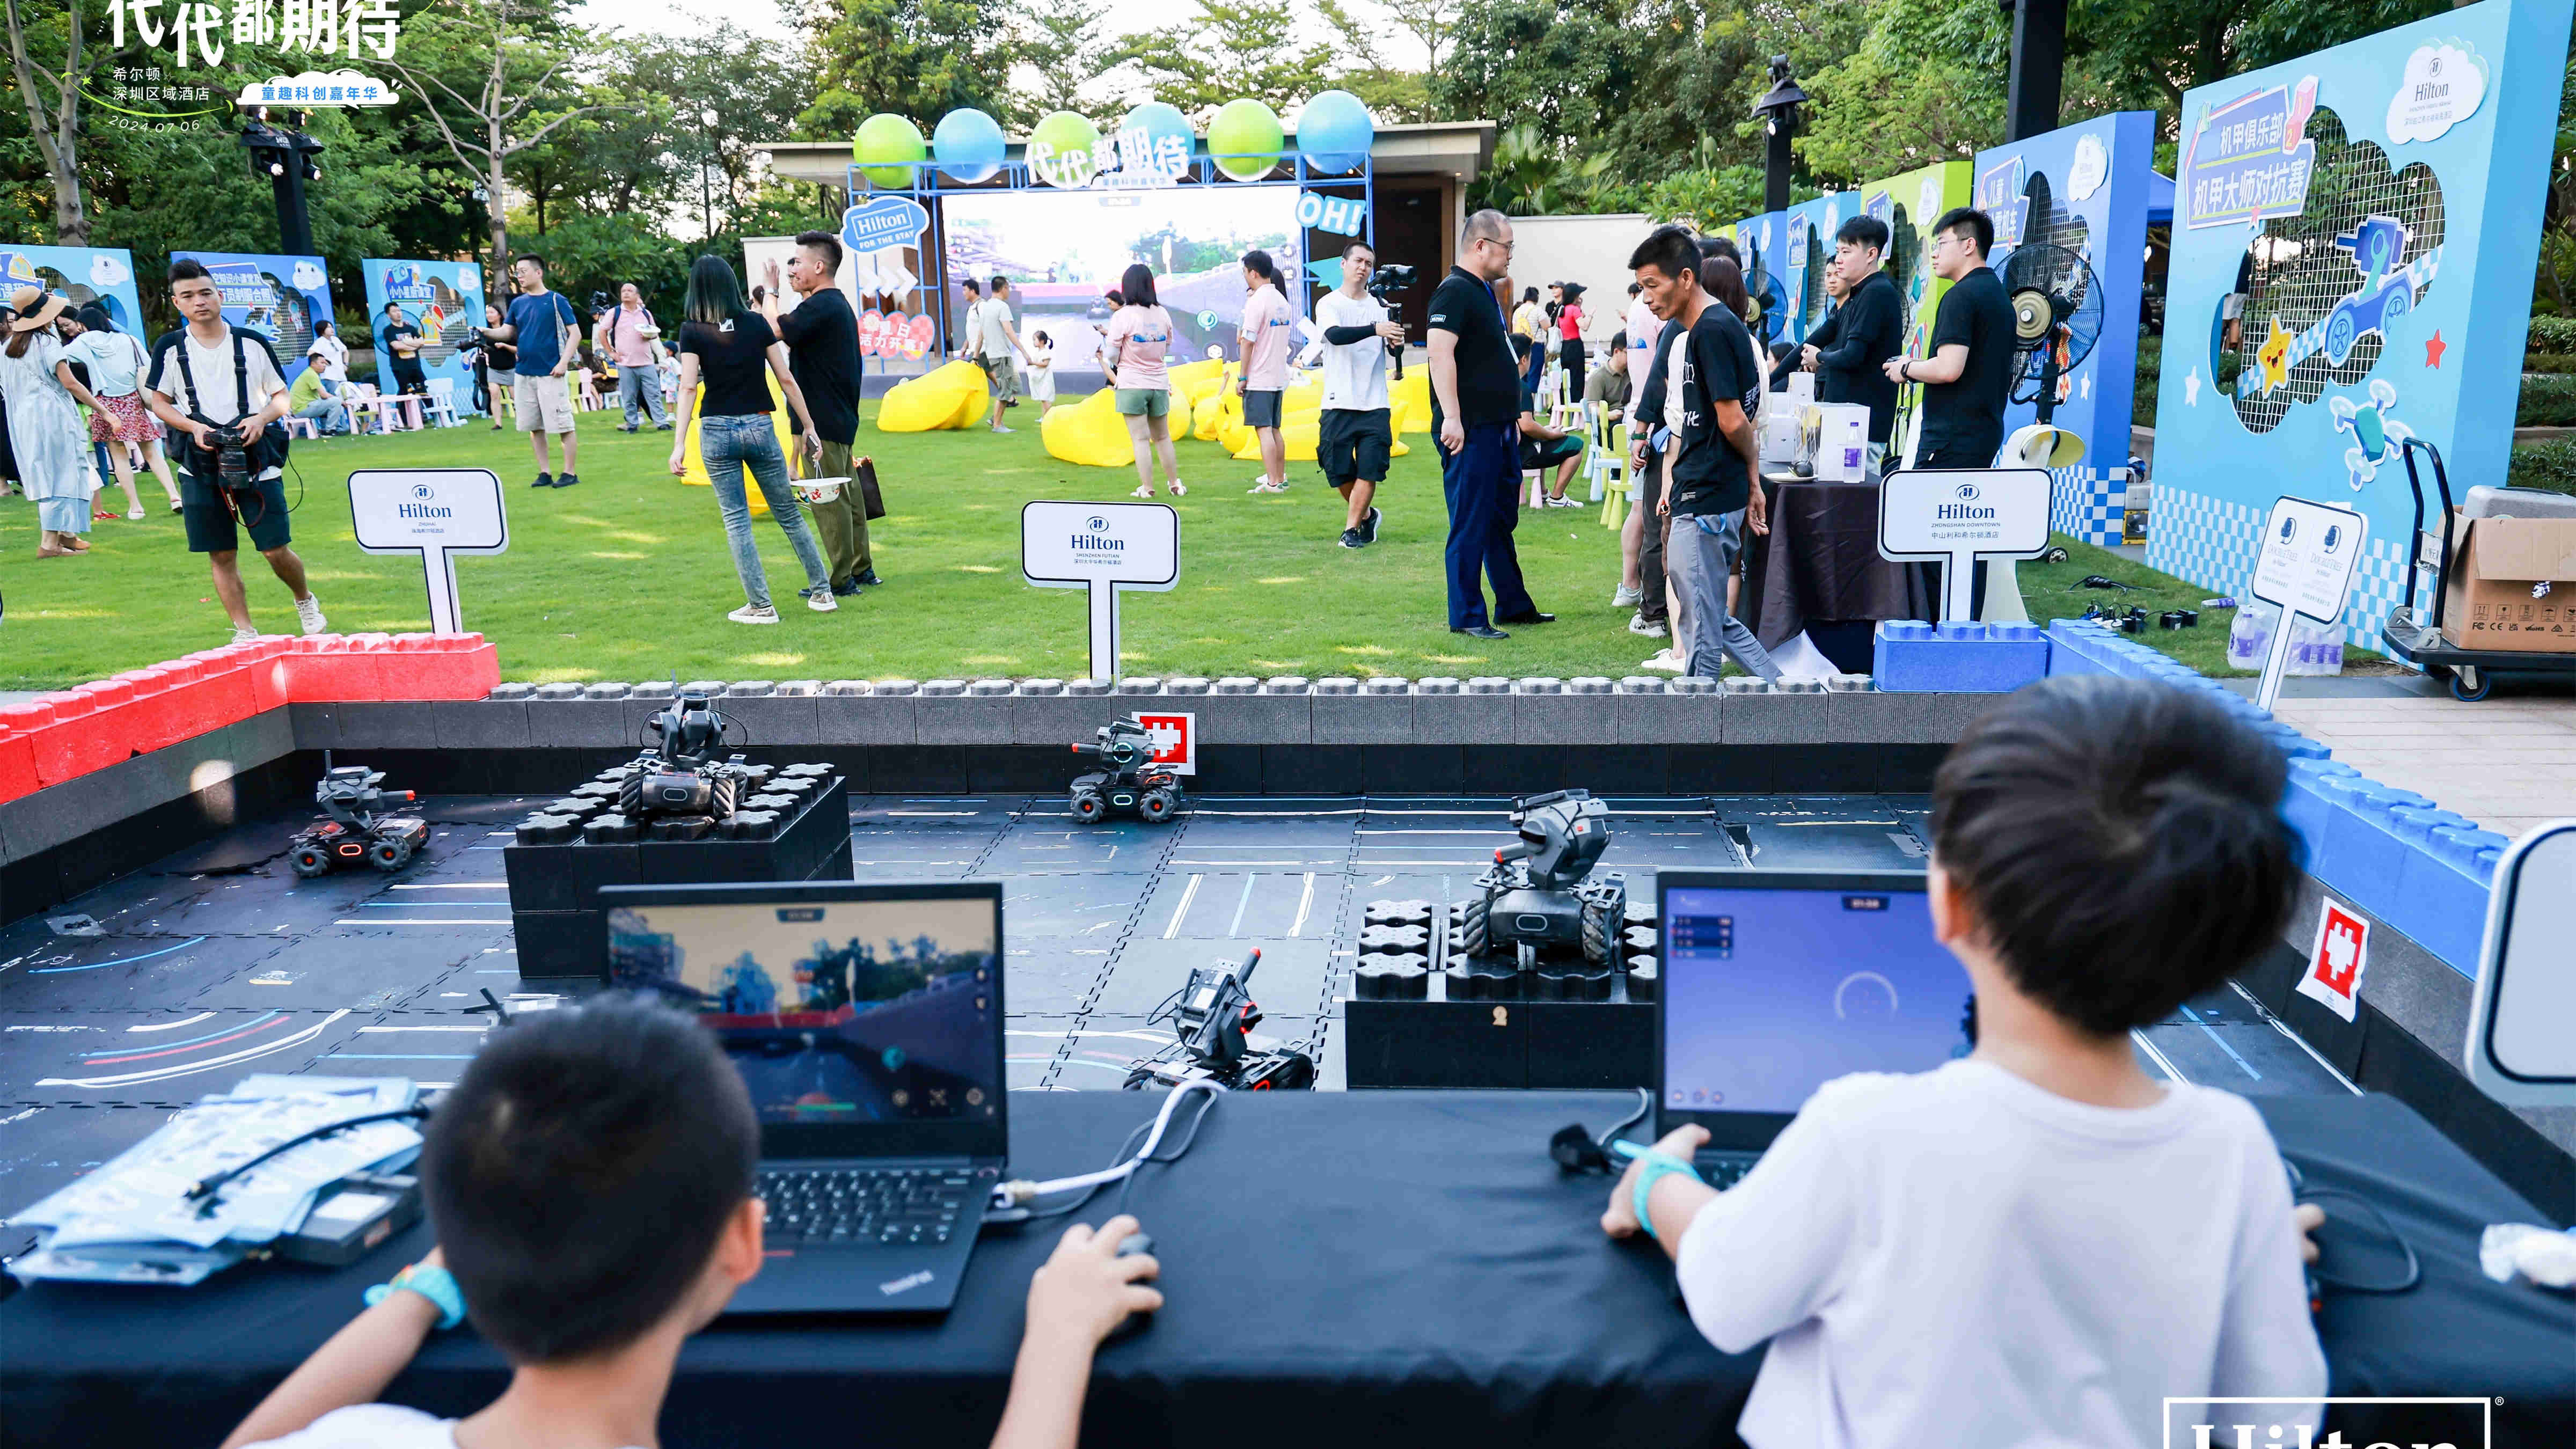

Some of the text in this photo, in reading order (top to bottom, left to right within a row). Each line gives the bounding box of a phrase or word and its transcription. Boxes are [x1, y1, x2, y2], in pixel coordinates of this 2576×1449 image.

[2415, 82, 2448, 102] Hilton
[2220, 112, 2285, 156] 机甲俱乐部
[1023, 126, 1189, 189] 代代都期待
[2193, 158, 2307, 218] 机甲大师对抗赛
[1298, 195, 1362, 230] OH!
[857, 213, 908, 235] Hilton
[859, 230, 915, 250] FOR THE STAY
[399, 503, 452, 518] Hilton
[1937, 503, 1995, 519] Hilton
[1071, 535, 1124, 550] Hilton
